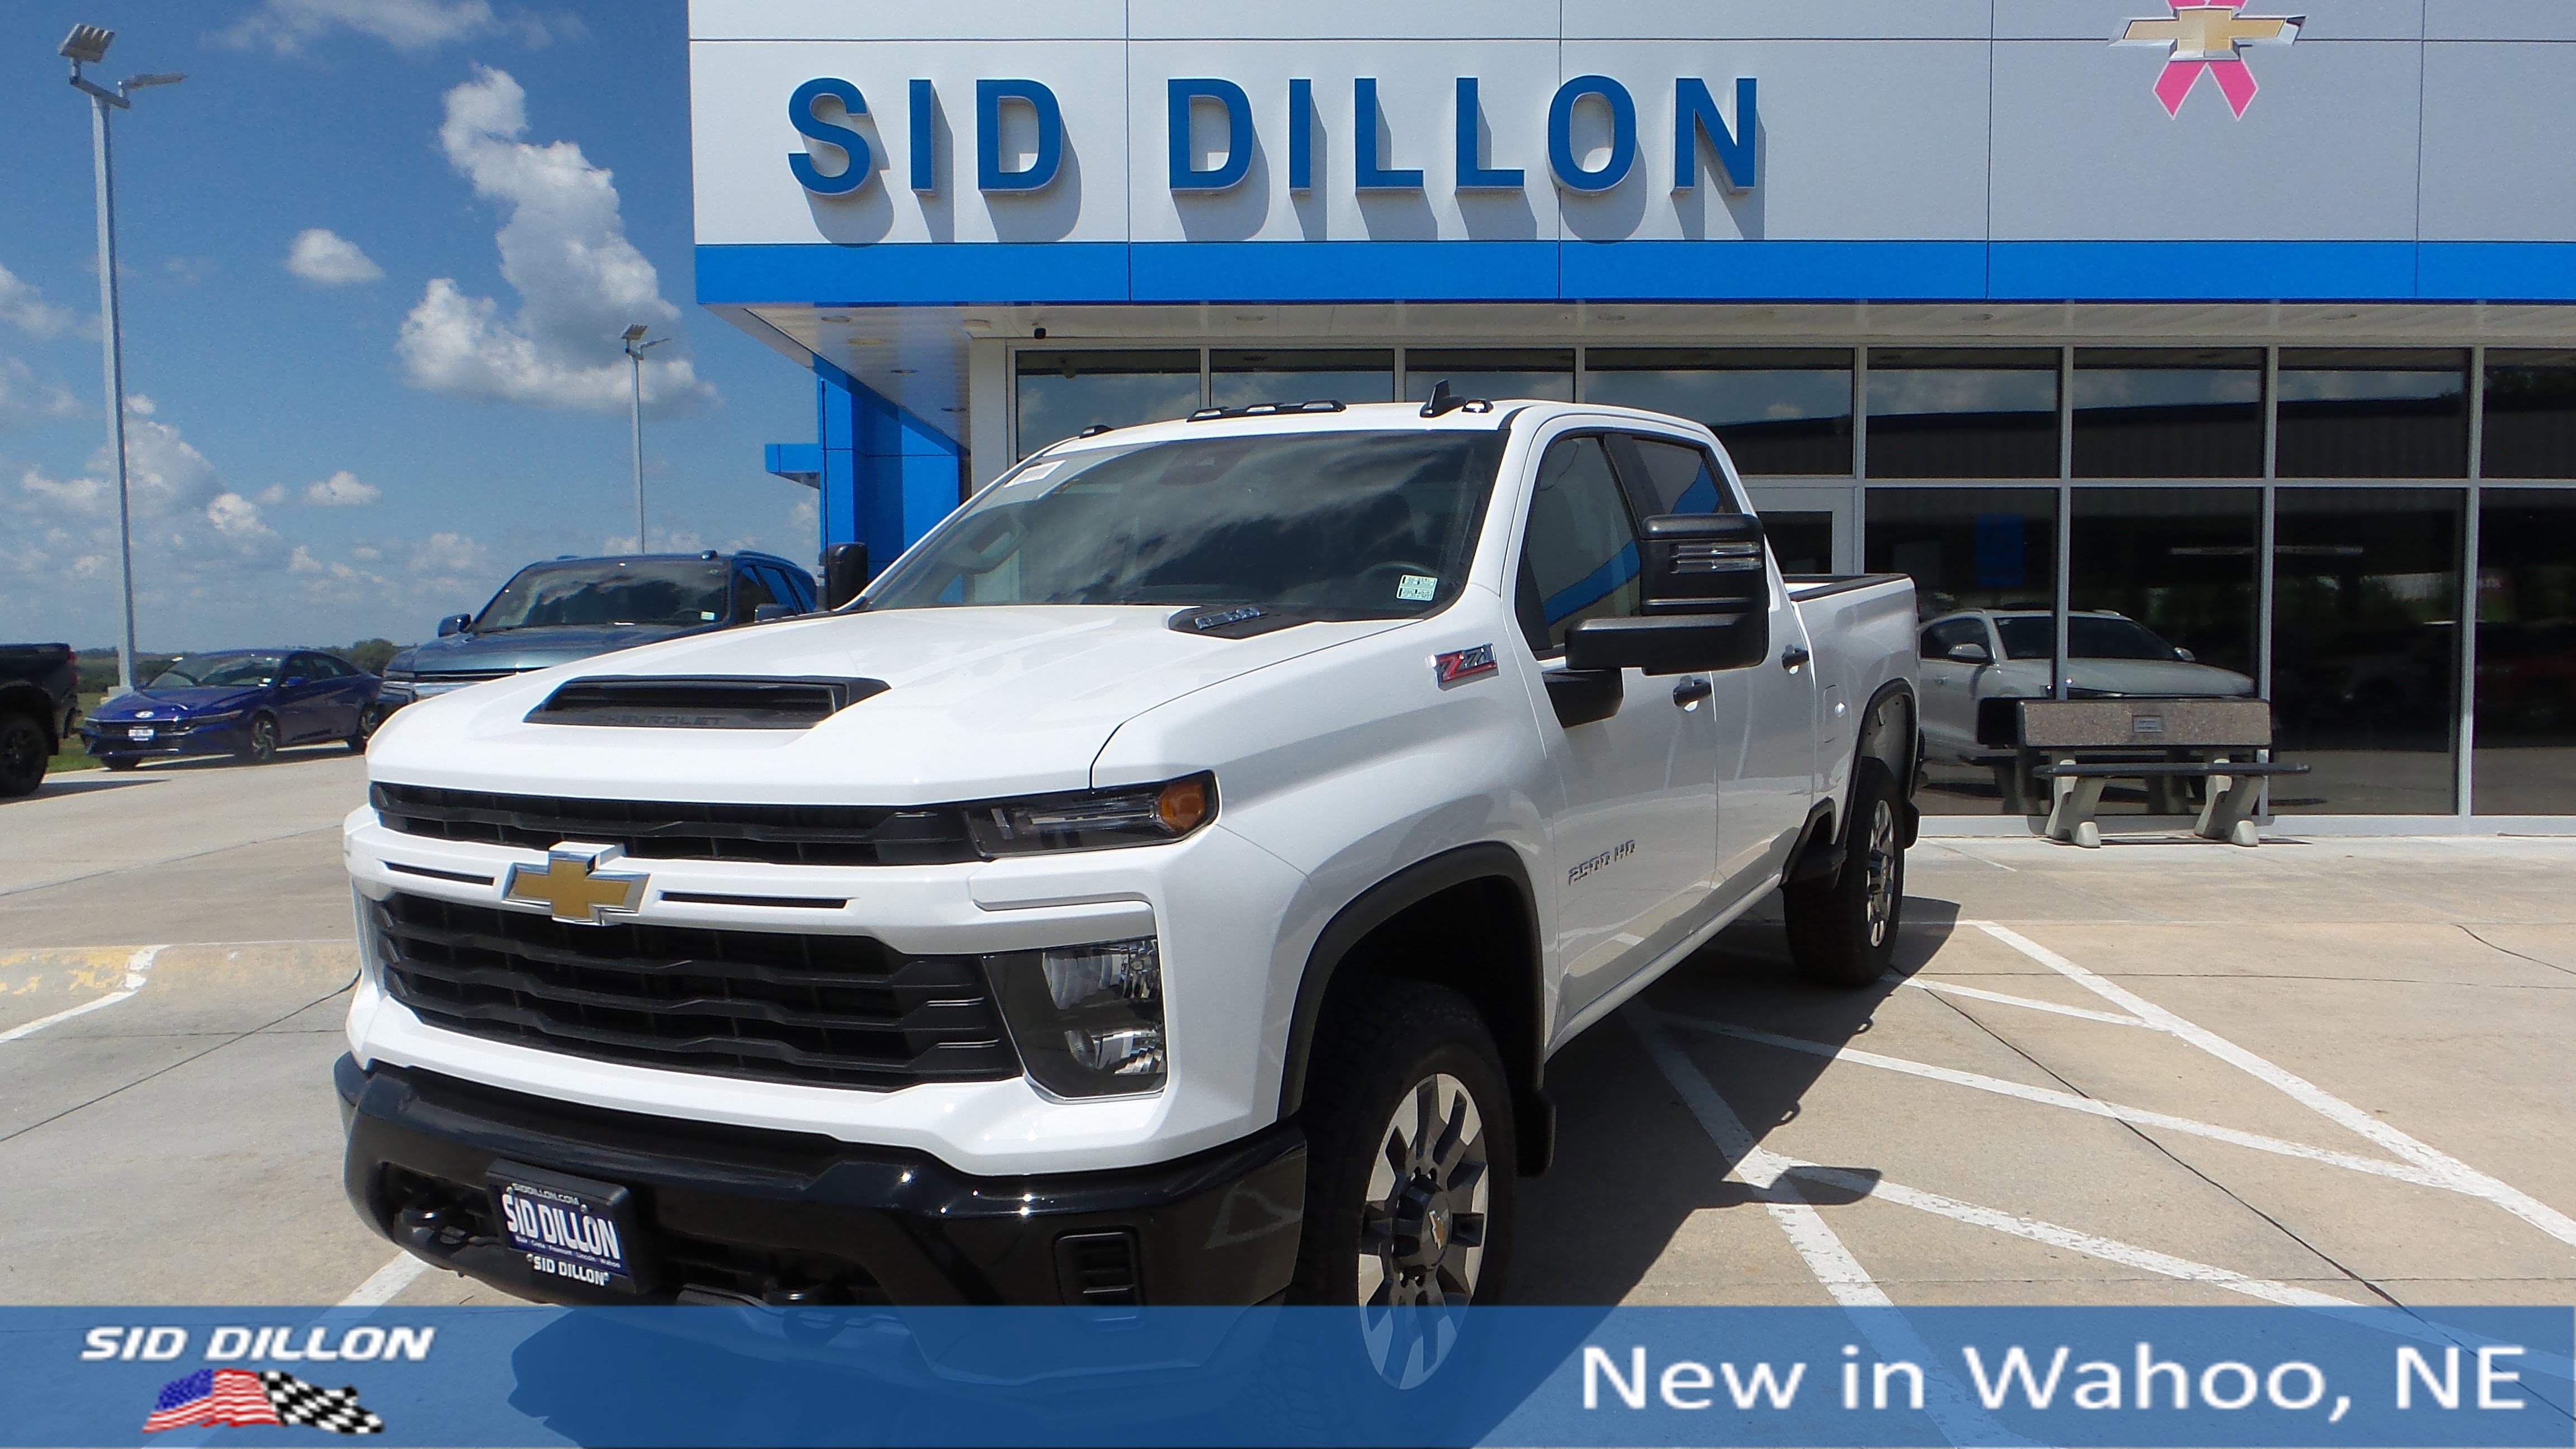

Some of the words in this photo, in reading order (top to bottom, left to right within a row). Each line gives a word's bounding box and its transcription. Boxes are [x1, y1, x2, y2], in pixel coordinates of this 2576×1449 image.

[788, 76, 1062, 196] SID
[1167, 75, 1758, 196] DILLON
[1436, 643, 1497, 683] Z71
[1568, 850, 1611, 886] 2500
[1614, 839, 1636, 862] HD
[502, 1193, 539, 1239] SID
[537, 1203, 621, 1260] DILLON
[533, 1256, 556, 1274] SID
[558, 1261, 606, 1286] DILLON
